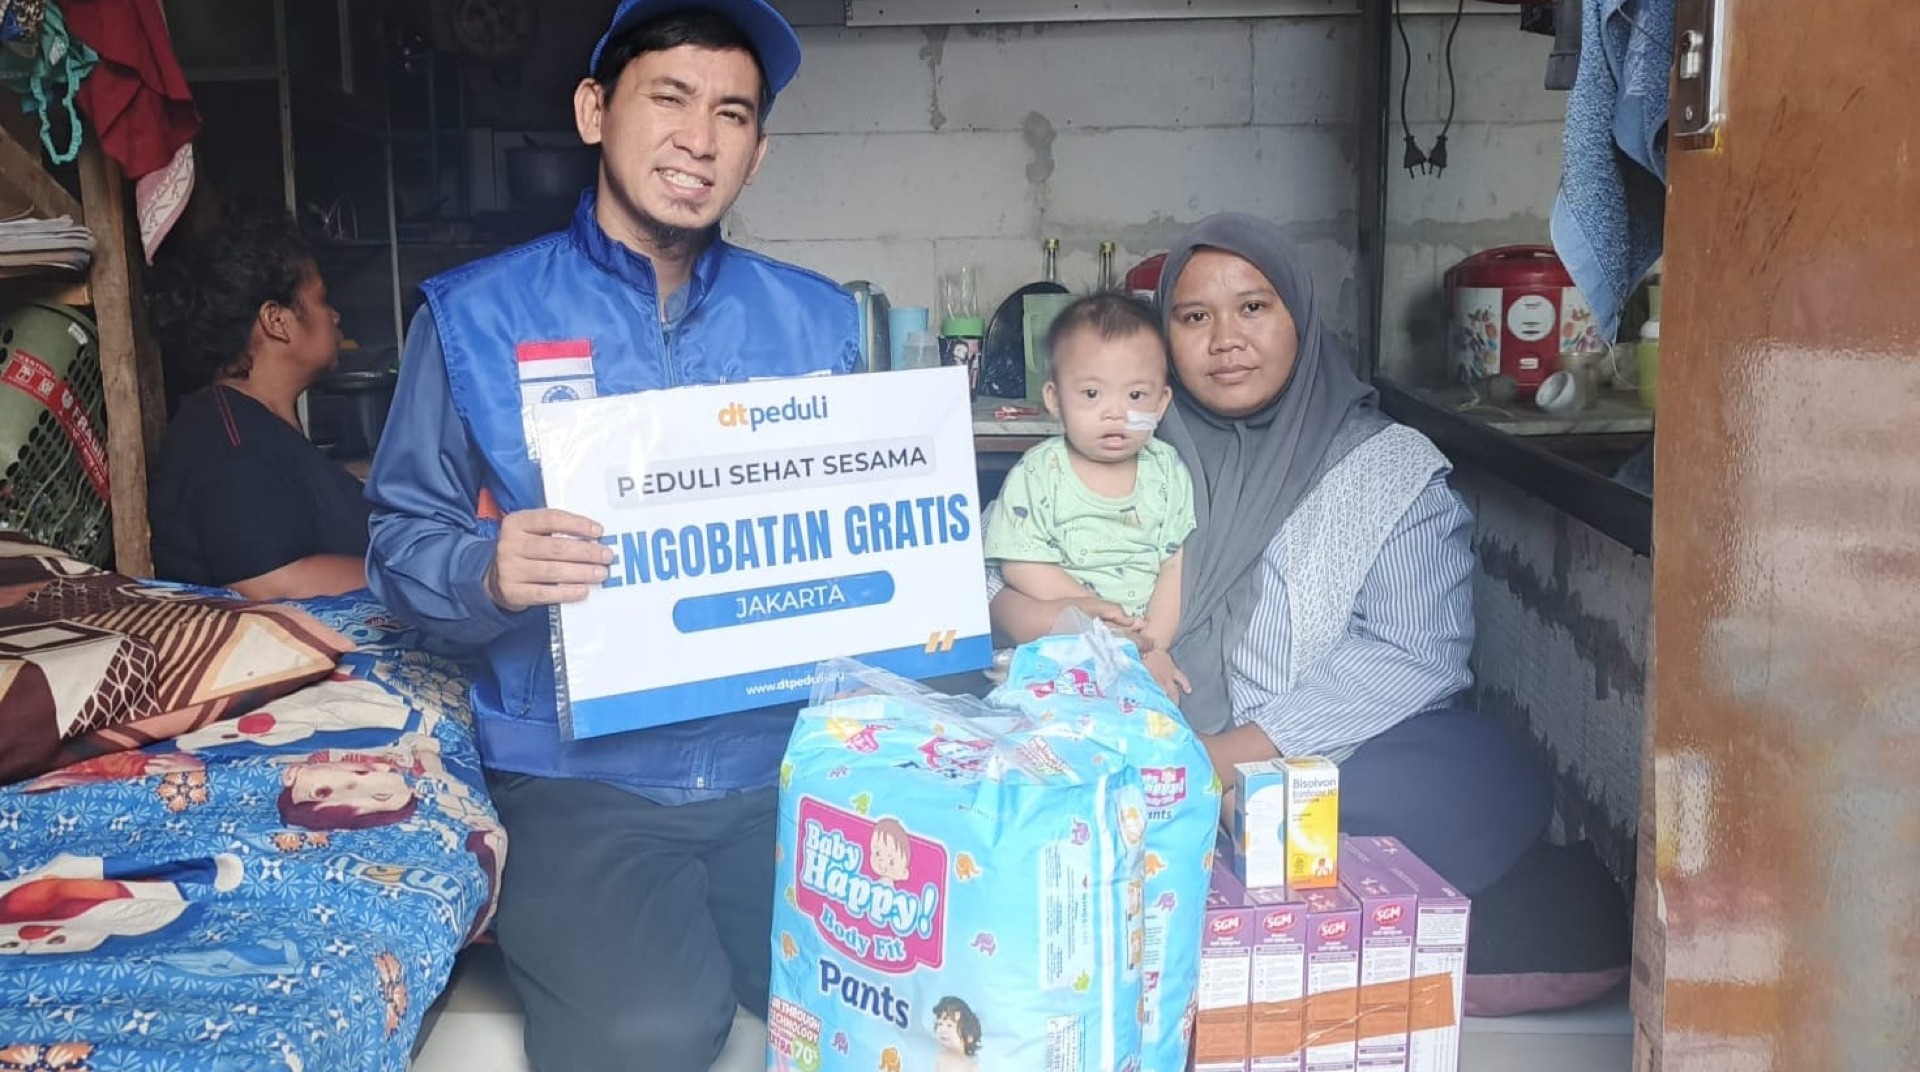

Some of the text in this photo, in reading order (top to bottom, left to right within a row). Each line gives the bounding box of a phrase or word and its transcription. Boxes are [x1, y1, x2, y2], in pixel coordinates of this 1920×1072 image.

[718, 395, 828, 432] dtpeduli
[617, 445, 928, 499] PEDULI SEHAT SESAMA
[599, 493, 972, 589] ENGOBATAN GRATIS
[735, 584, 846, 619] JAKARTA
[1293, 777, 1337, 789] Bisolvon
[805, 821, 862, 871] Baby
[802, 852, 938, 937] Happy!
[1212, 917, 1240, 932] SGM
[1265, 912, 1292, 928] SGM
[1320, 921, 1347, 937] SGM
[1375, 905, 1402, 922] SGM
[820, 904, 906, 961] Body Fit
[819, 958, 910, 1029] Pants
[782, 1001, 821, 1032] THROUGH
